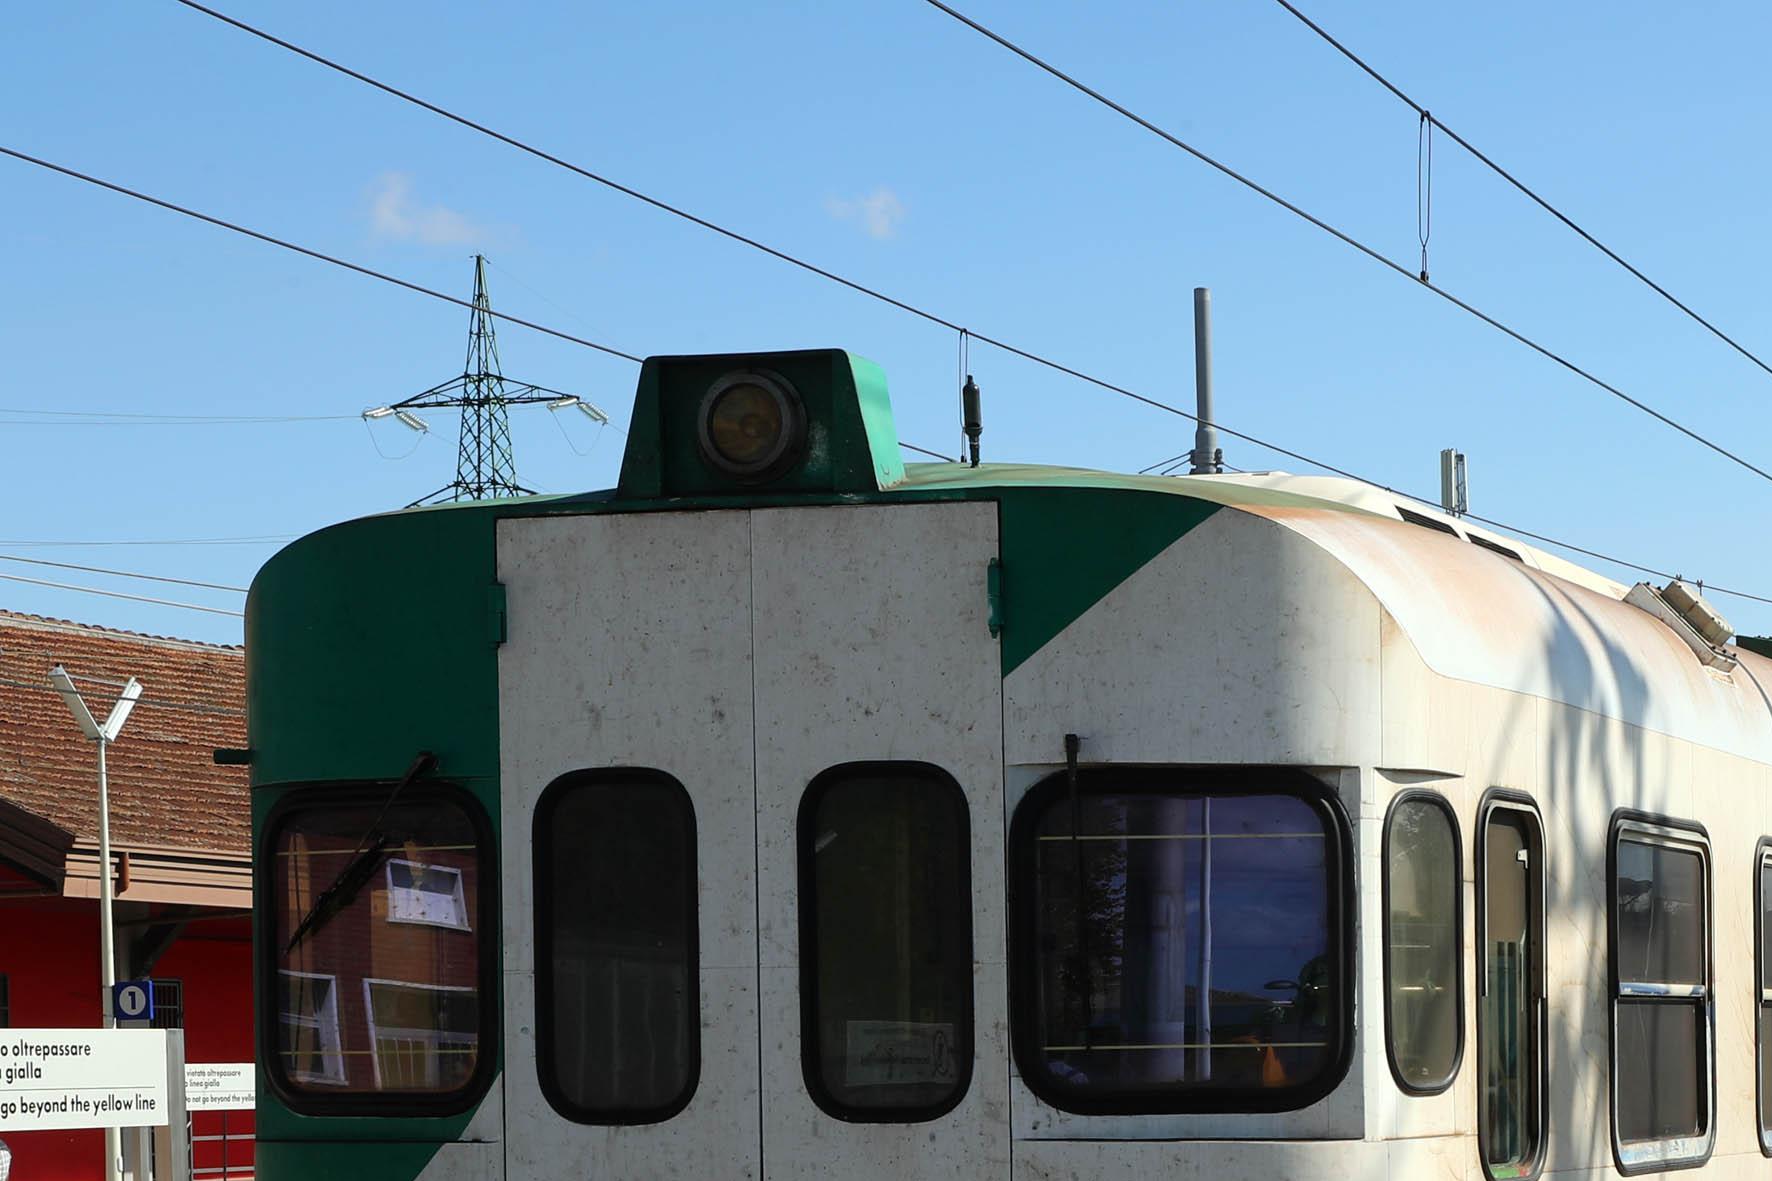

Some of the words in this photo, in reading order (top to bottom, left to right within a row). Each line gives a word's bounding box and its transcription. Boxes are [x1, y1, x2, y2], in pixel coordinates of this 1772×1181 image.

[128, 991, 136, 1010] 1
[12, 1038, 92, 1061] oltrepassare
[5, 1061, 42, 1084] gialla
[1, 1102, 17, 1120] go
[20, 1095, 68, 1119] beyond
[71, 1094, 91, 1112] the
[93, 1093, 134, 1116] yellow
[136, 1093, 156, 1111] line
[210, 1093, 231, 1104] beyond
